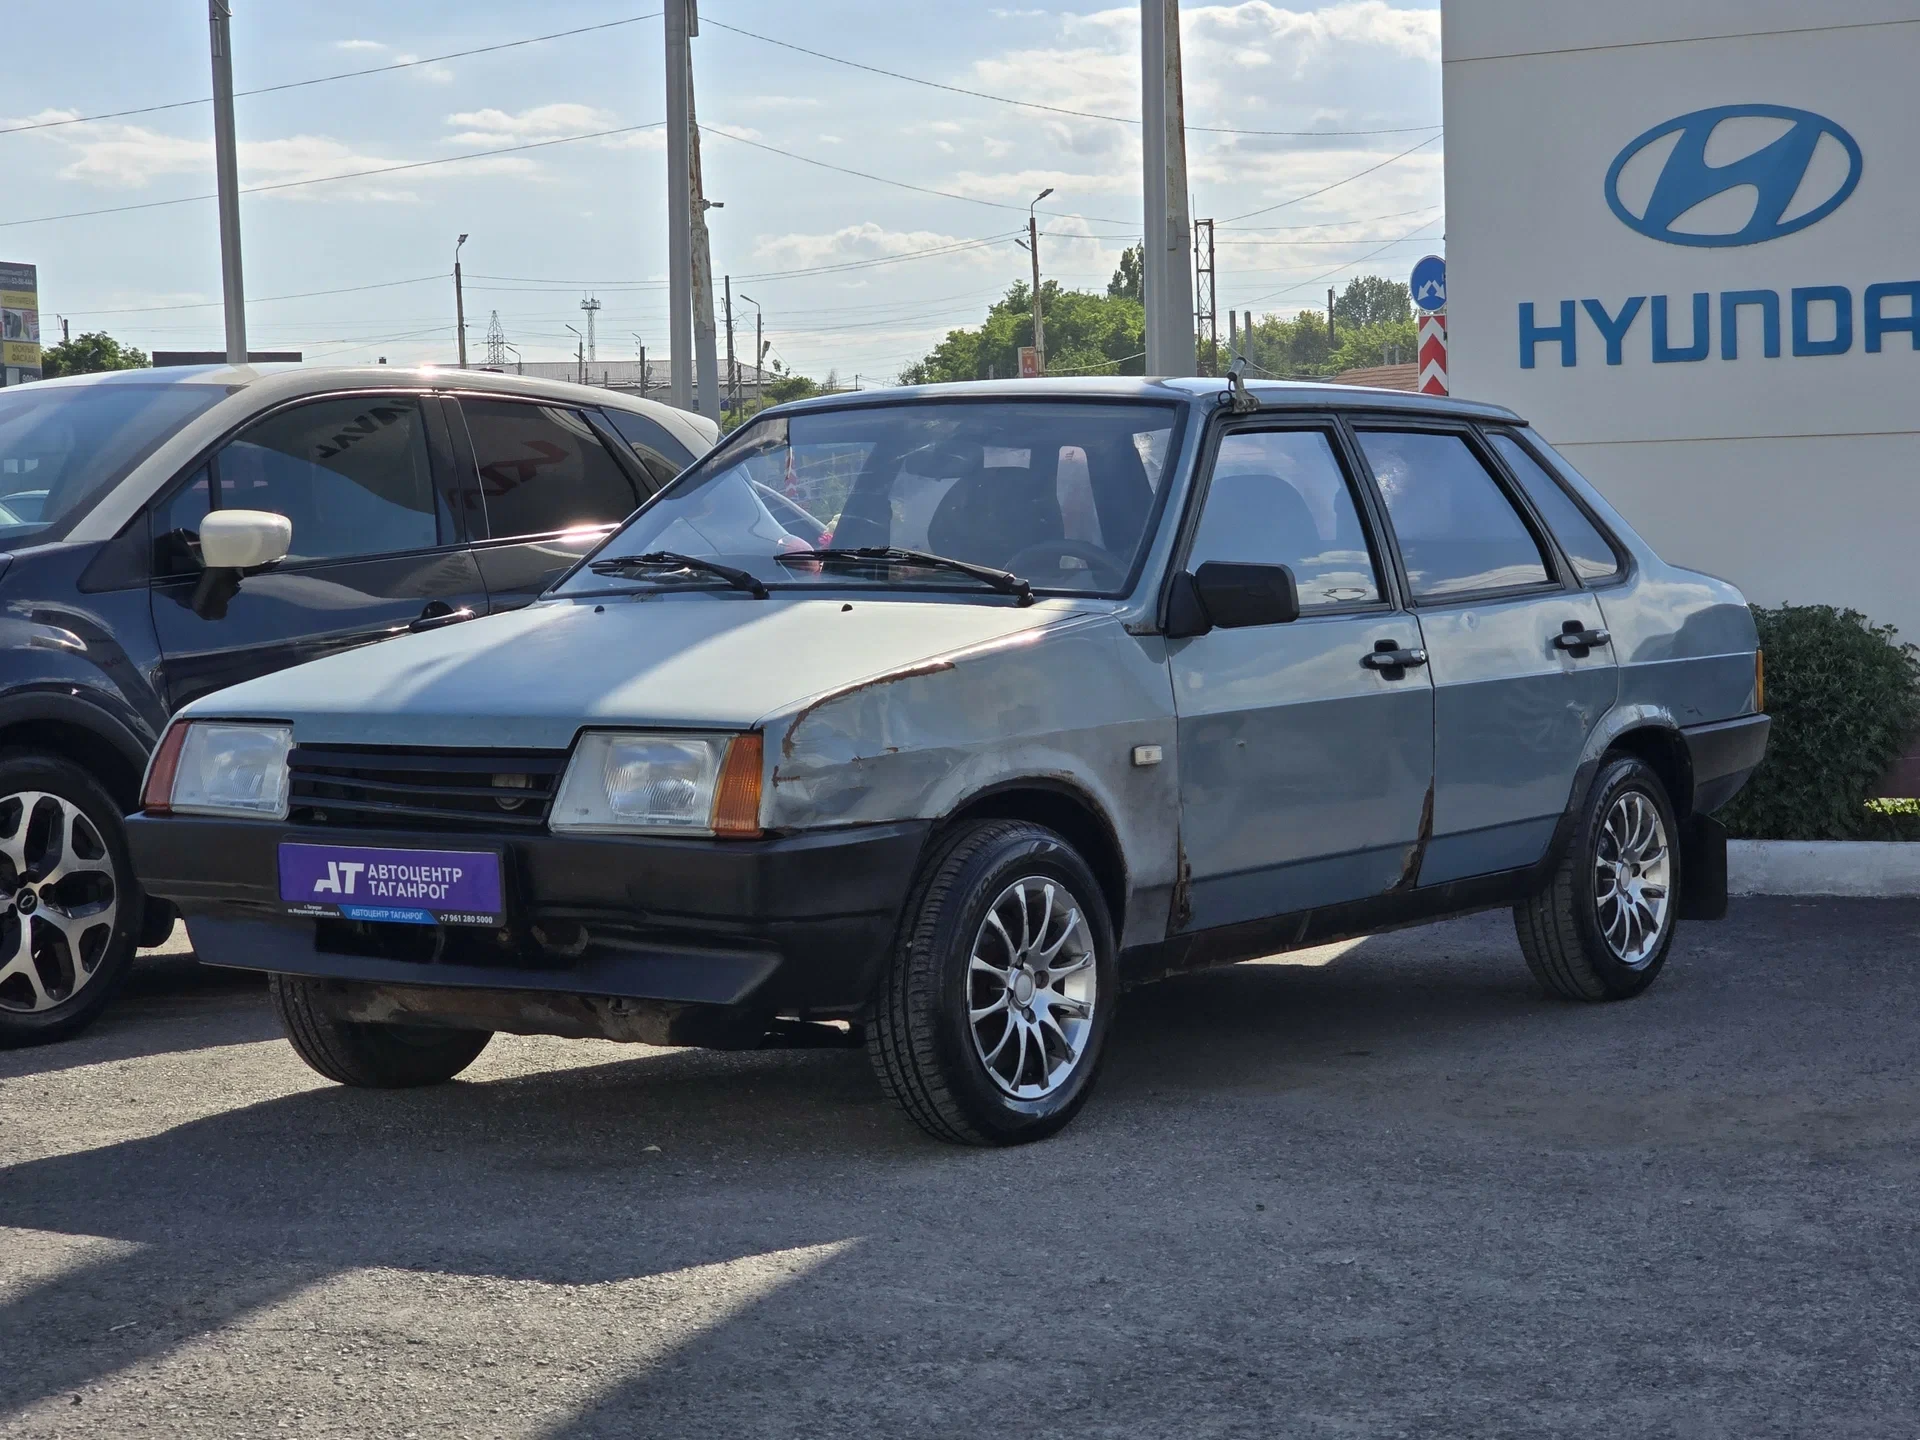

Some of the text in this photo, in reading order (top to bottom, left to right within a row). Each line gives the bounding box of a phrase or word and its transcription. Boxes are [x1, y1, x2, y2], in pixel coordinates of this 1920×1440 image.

[367, 863, 463, 883] АВТОЦЕНТР
[368, 880, 449, 900] ТАГАНРОГ
[351, 908, 389, 919] АВТОЦЕНТР
[390, 911, 424, 921] ТАГАНРОГ
[440, 914, 448, 922] +7
[449, 914, 462, 922] 961
[476, 915, 493, 924] 5000
